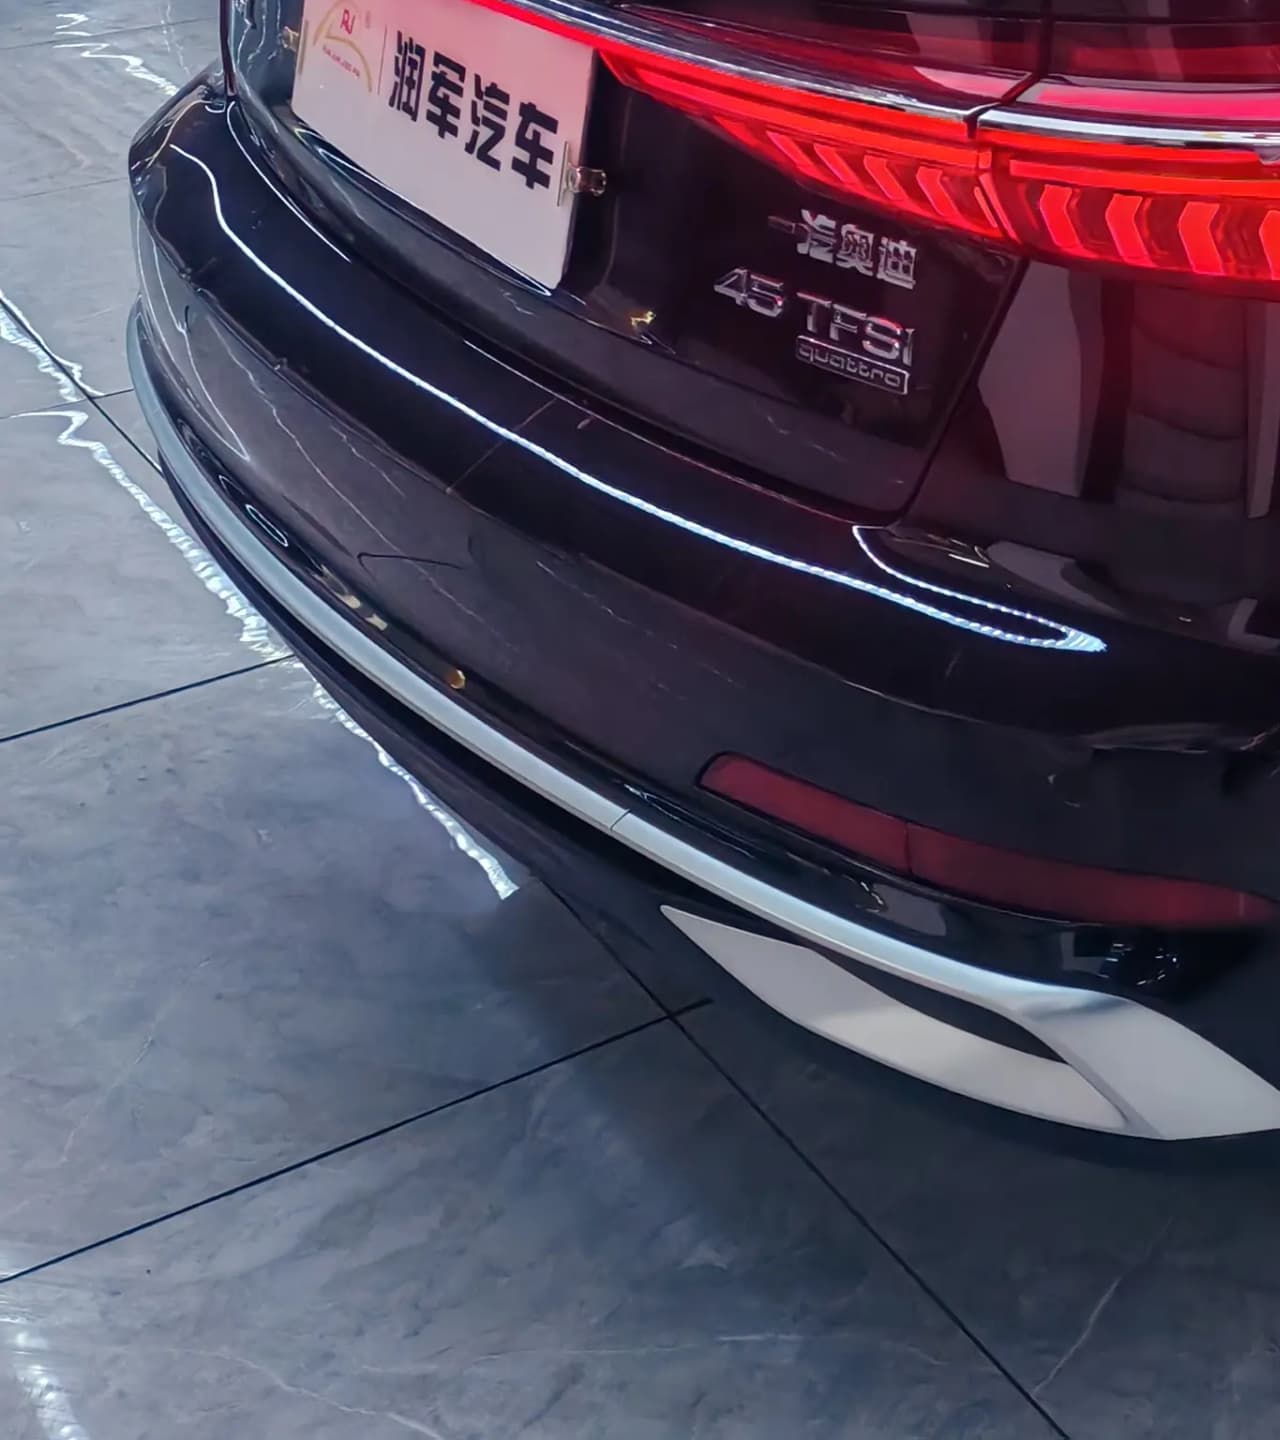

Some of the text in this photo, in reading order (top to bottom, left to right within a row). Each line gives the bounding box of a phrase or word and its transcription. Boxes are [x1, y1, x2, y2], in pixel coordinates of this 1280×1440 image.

[388, 29, 559, 190] 润军汽车
[713, 268, 915, 367] 45 TFSI
[798, 342, 903, 389] quattro
